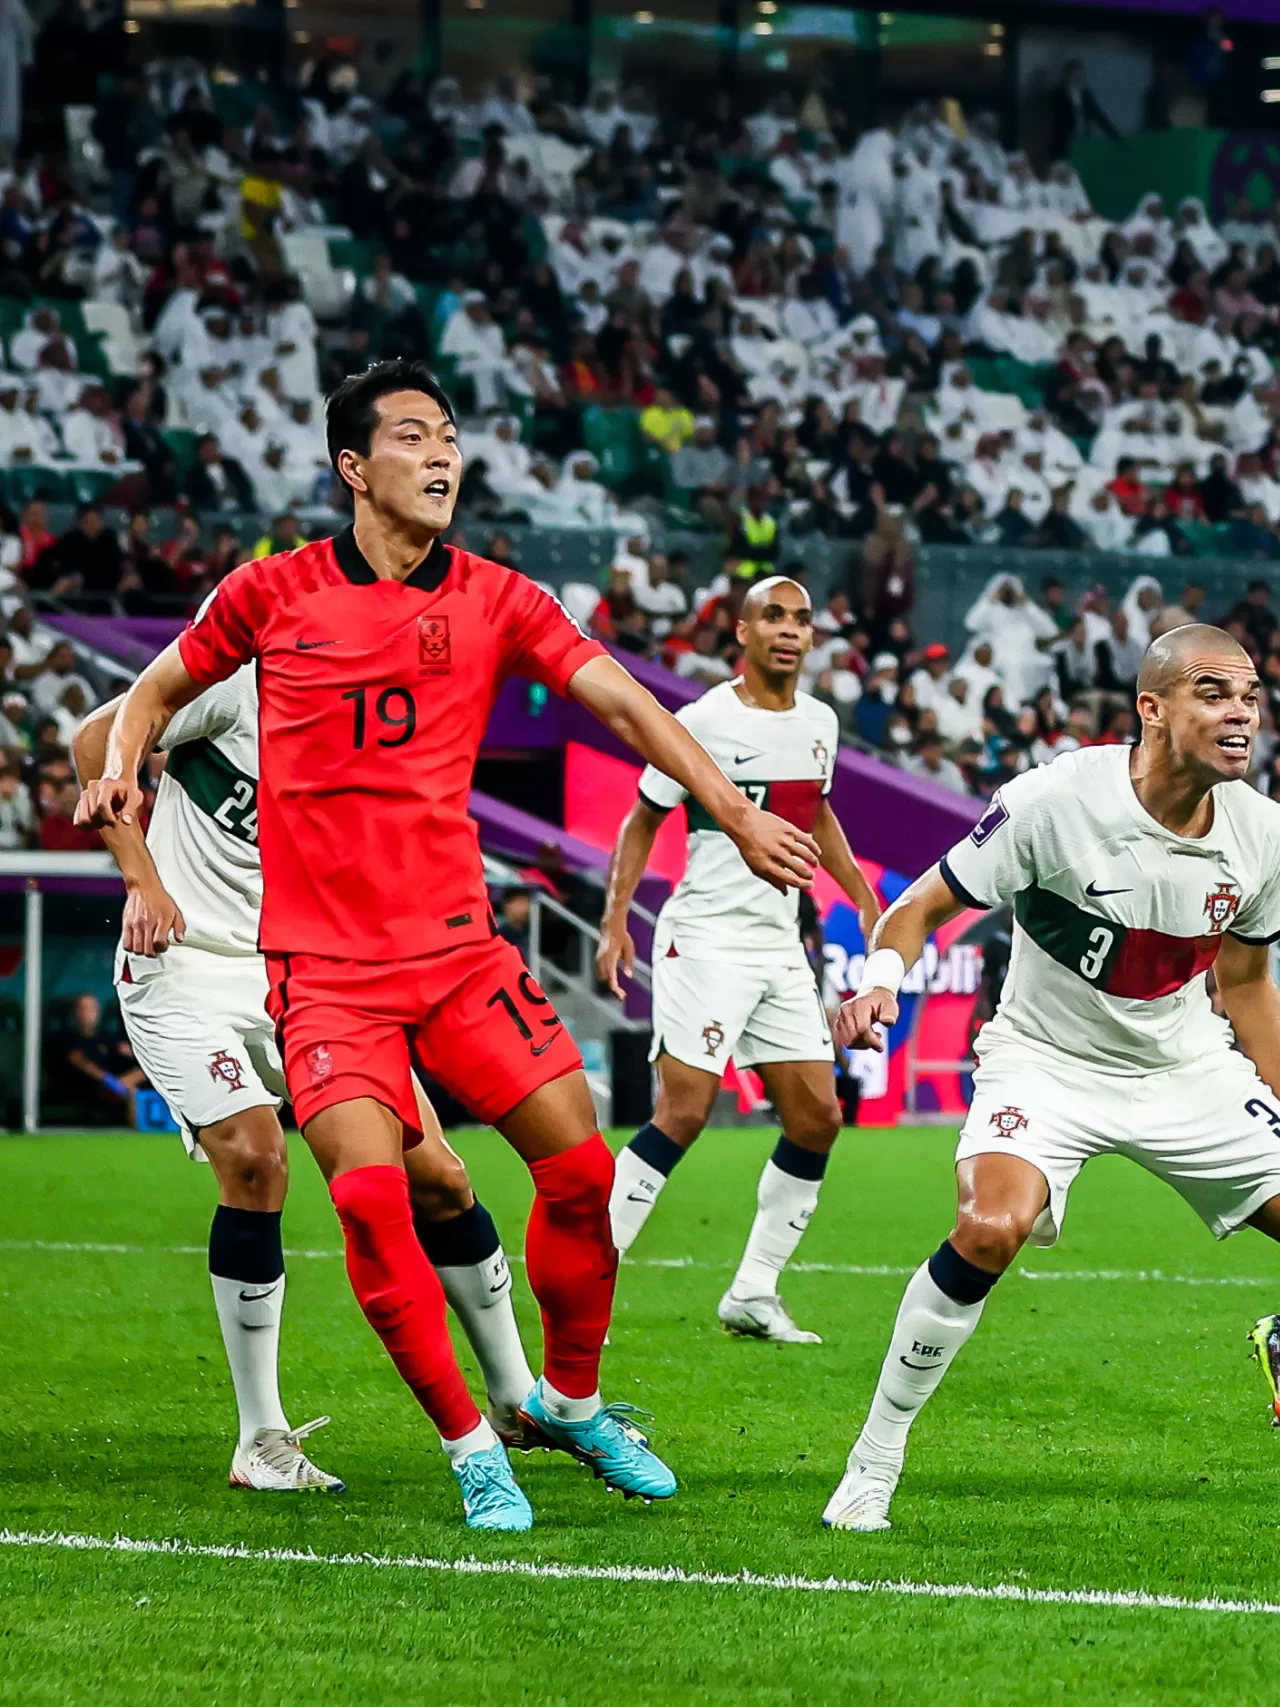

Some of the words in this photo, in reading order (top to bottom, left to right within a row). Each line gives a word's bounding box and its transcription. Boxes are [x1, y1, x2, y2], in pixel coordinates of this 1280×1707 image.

[341, 686, 416, 750] 19
[737, 785, 767, 810] 7
[1079, 926, 1114, 980] 3
[486, 971, 561, 1041] 19
